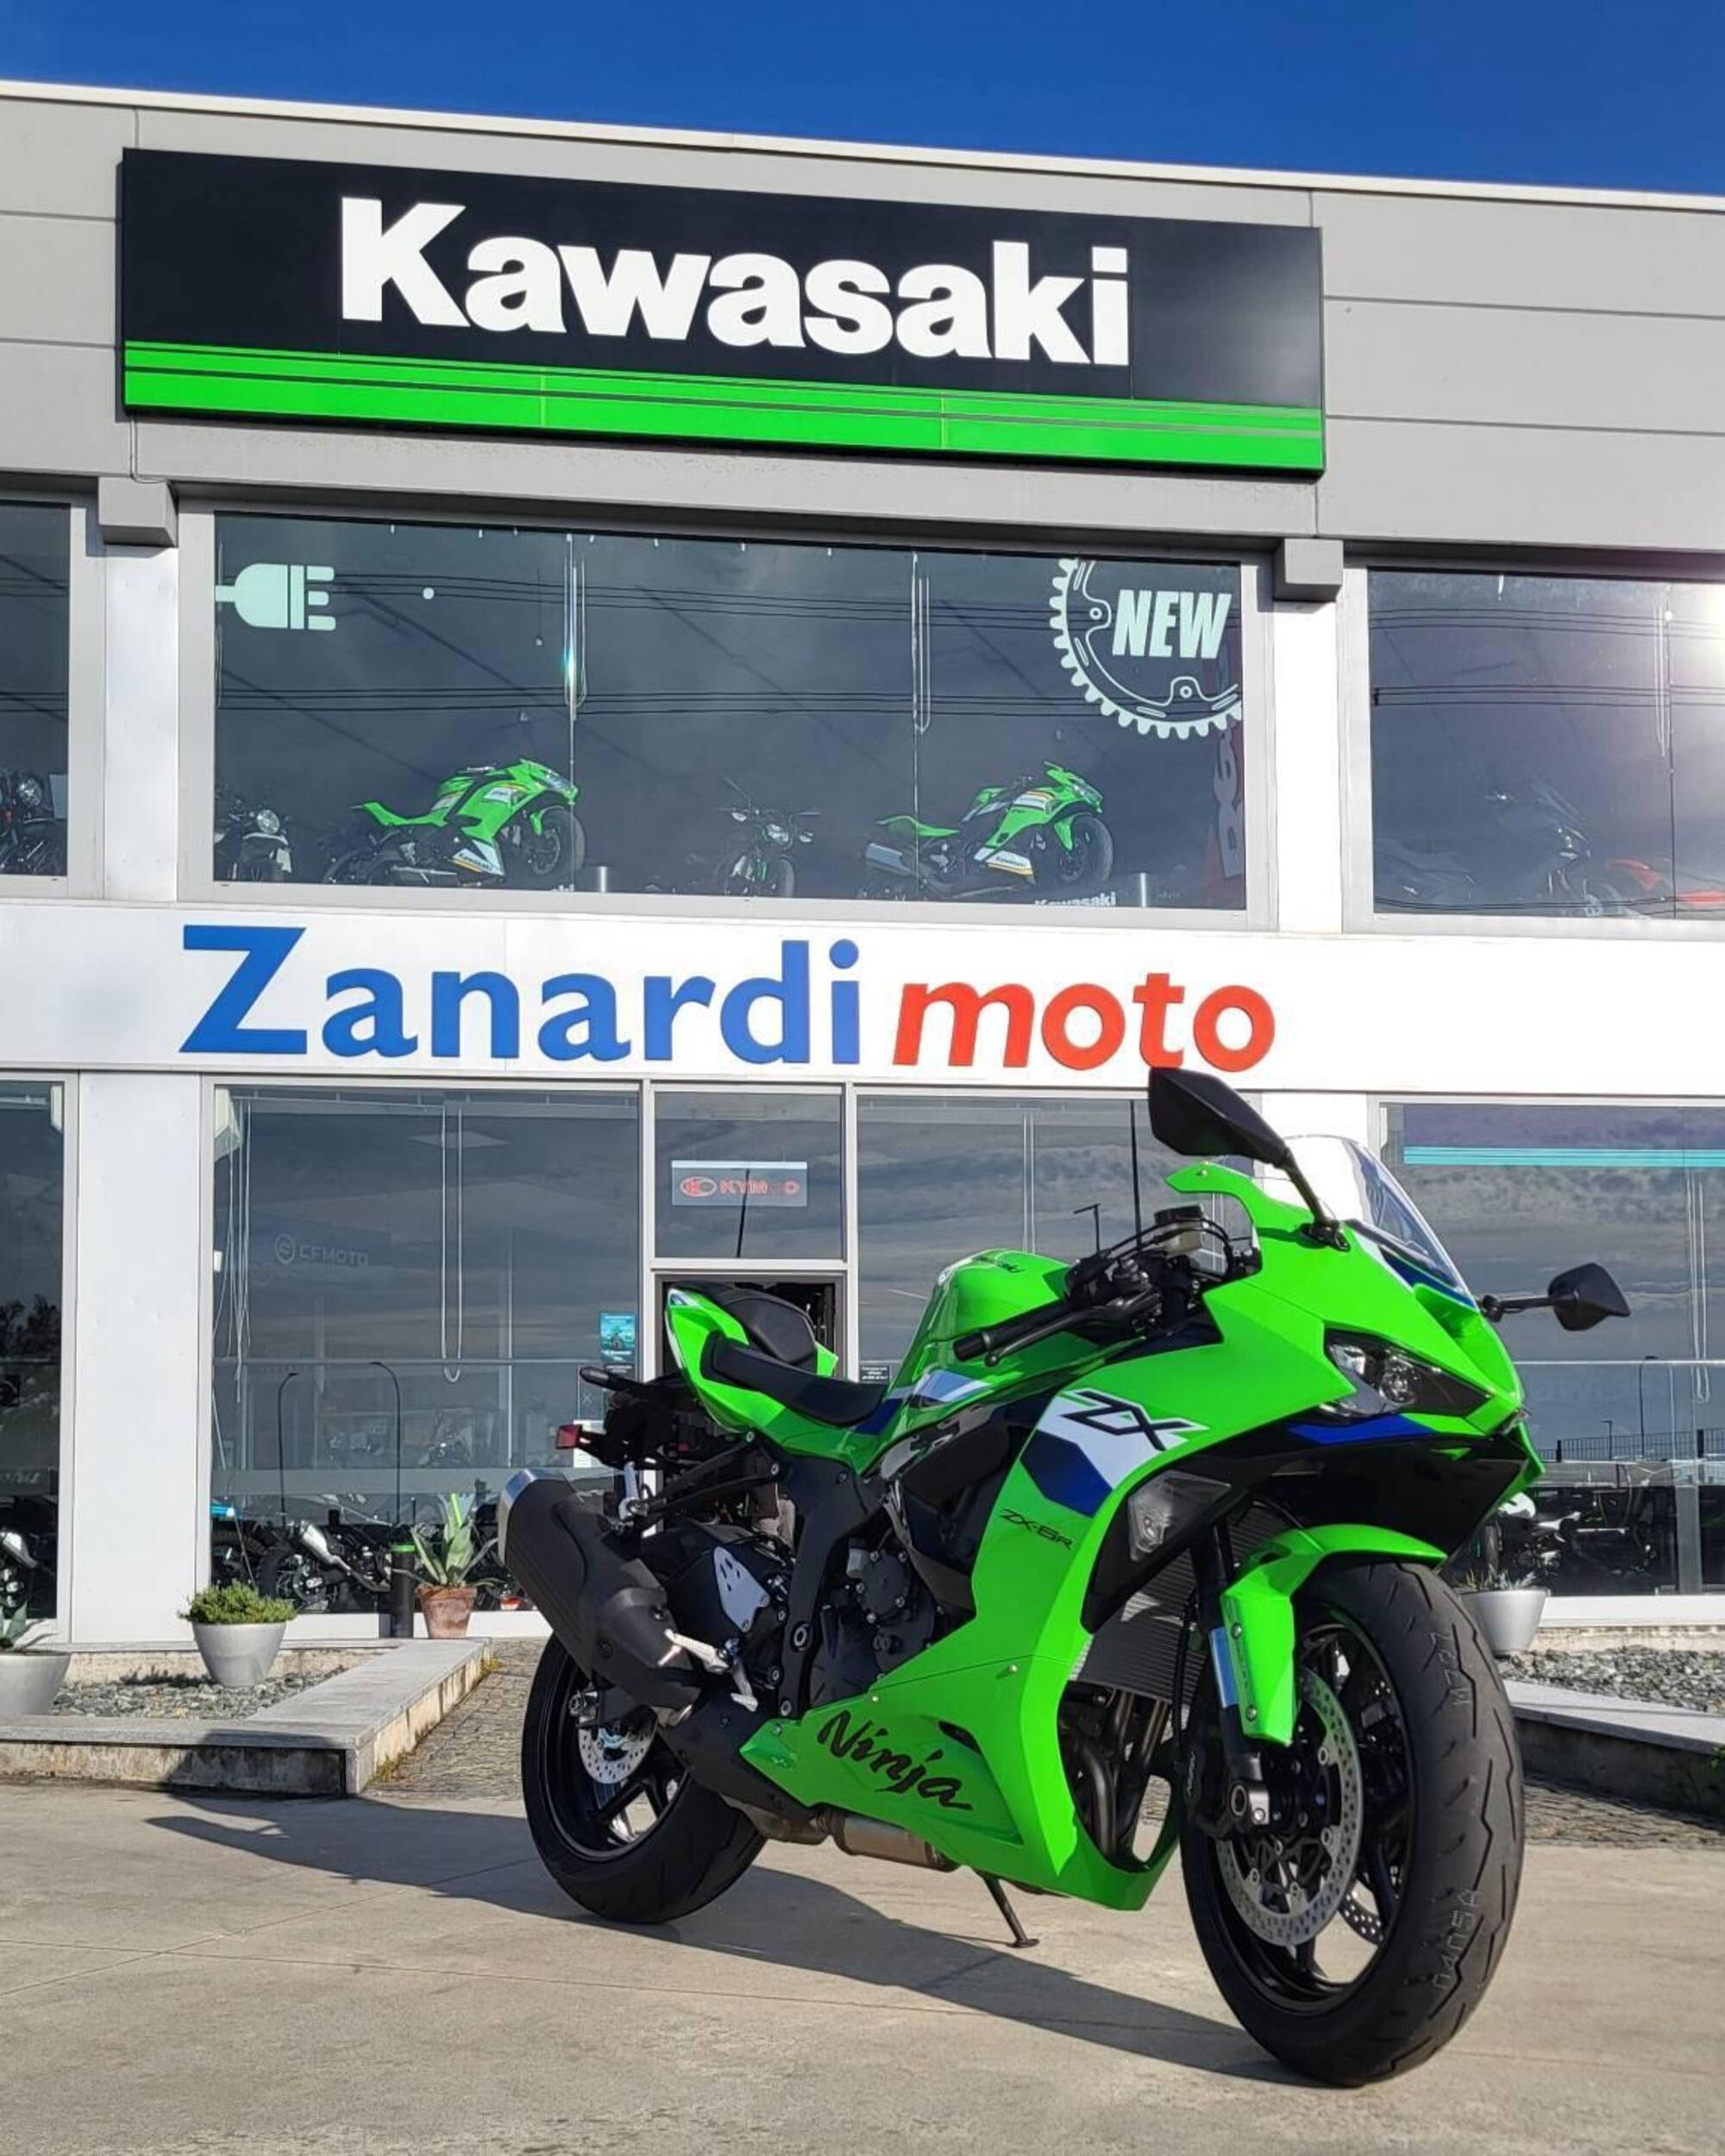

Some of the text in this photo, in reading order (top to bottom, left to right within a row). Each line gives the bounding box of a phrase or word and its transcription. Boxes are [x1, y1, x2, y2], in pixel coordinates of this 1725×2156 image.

[340, 196, 1130, 367] Kawasaki
[1112, 588, 1233, 660] NEW
[180, 924, 1276, 1074] Zanardi moto
[1059, 1389, 1194, 1452] ZX
[816, 1709, 975, 1811] Ninja
